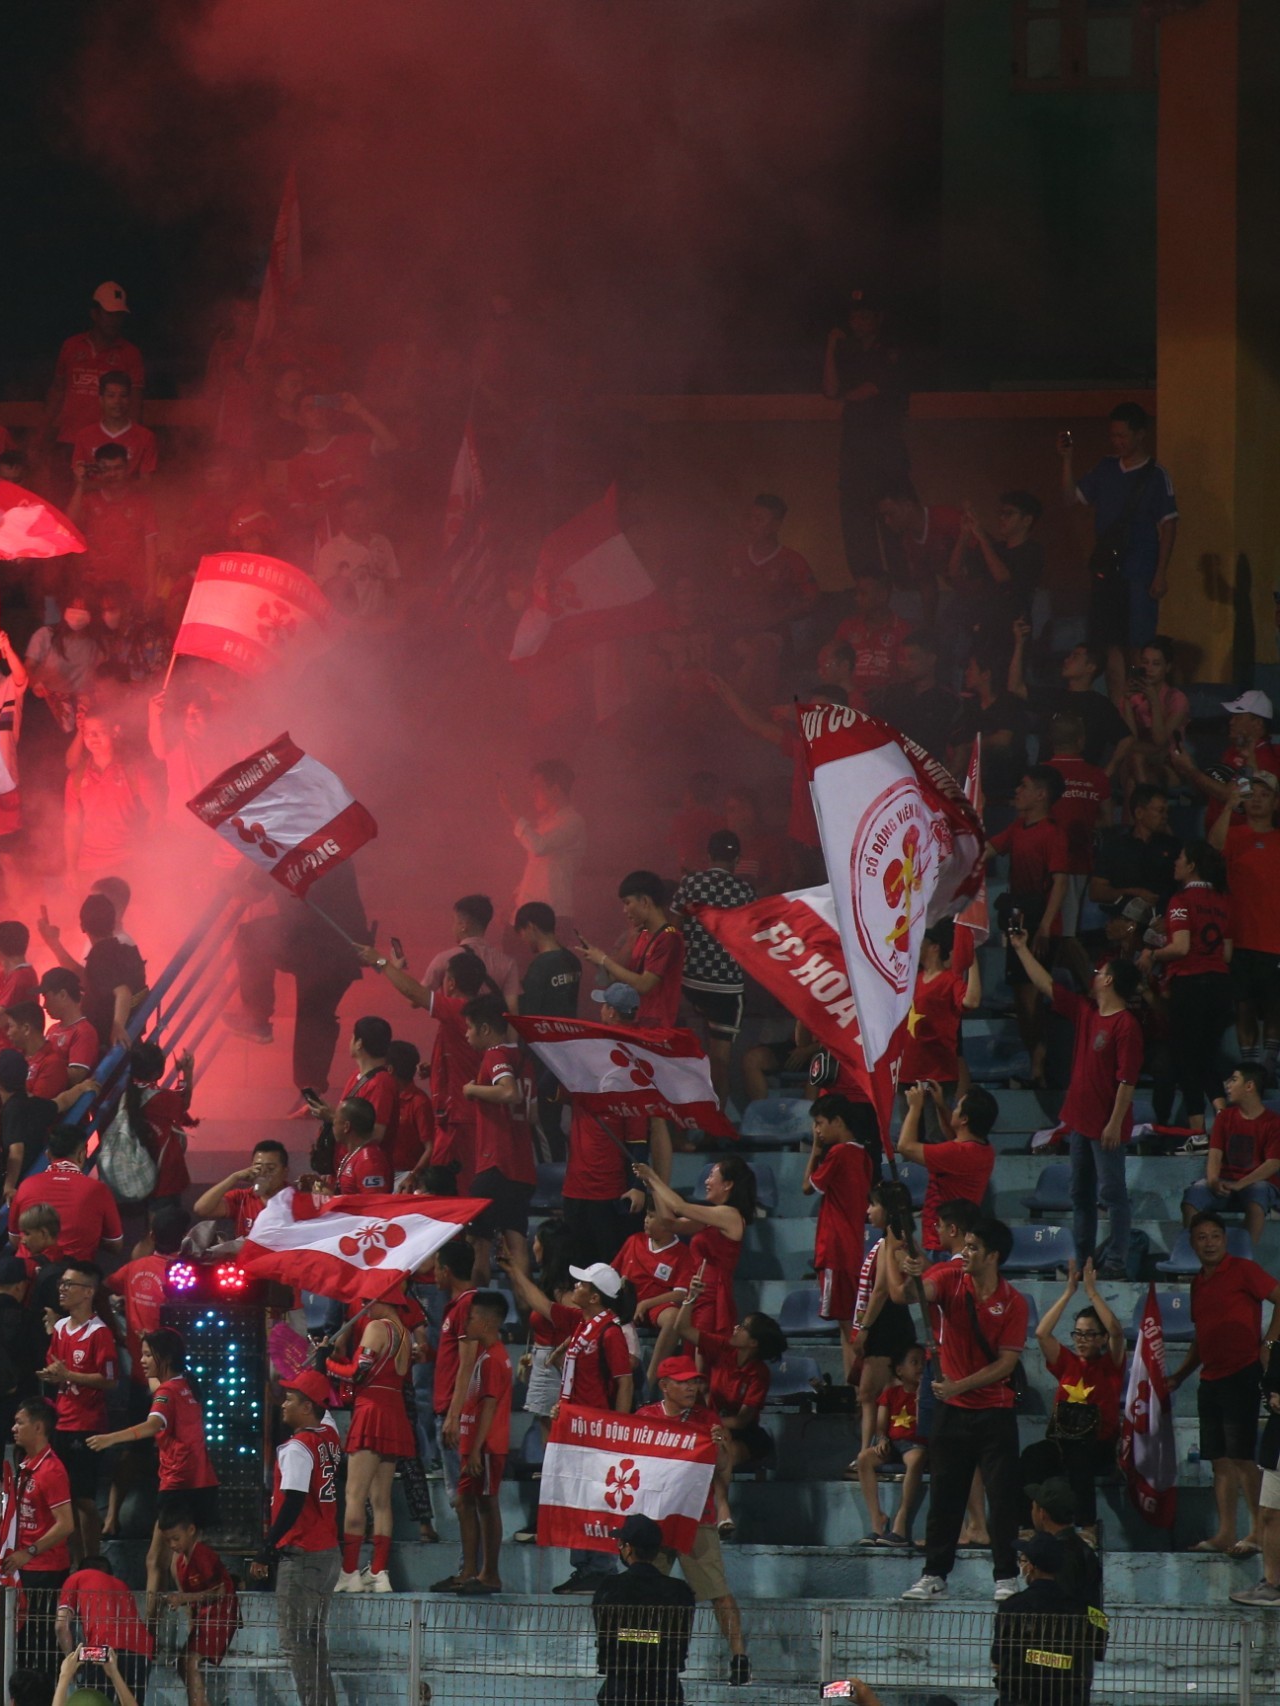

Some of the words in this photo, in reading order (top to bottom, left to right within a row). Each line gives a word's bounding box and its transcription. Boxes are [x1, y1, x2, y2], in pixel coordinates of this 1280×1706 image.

[871, 817, 898, 856] ĐỘNG
[752, 921, 806, 962] FC
[790, 955, 861, 1028] HOA
[900, 1167, 909, 1178] 4
[1034, 1230, 1043, 1242] 5
[1172, 1297, 1181, 1309] 6
[571, 1416, 587, 1440] HỘI
[605, 1421, 630, 1444] ĐỘNG
[632, 1424, 654, 1445] VIÊN
[654, 1429, 681, 1447] BÓNG
[681, 1432, 698, 1451] ĐÁ
[584, 1520, 609, 1538] HẢI
[1026, 1650, 1071, 1668] SECURITY
